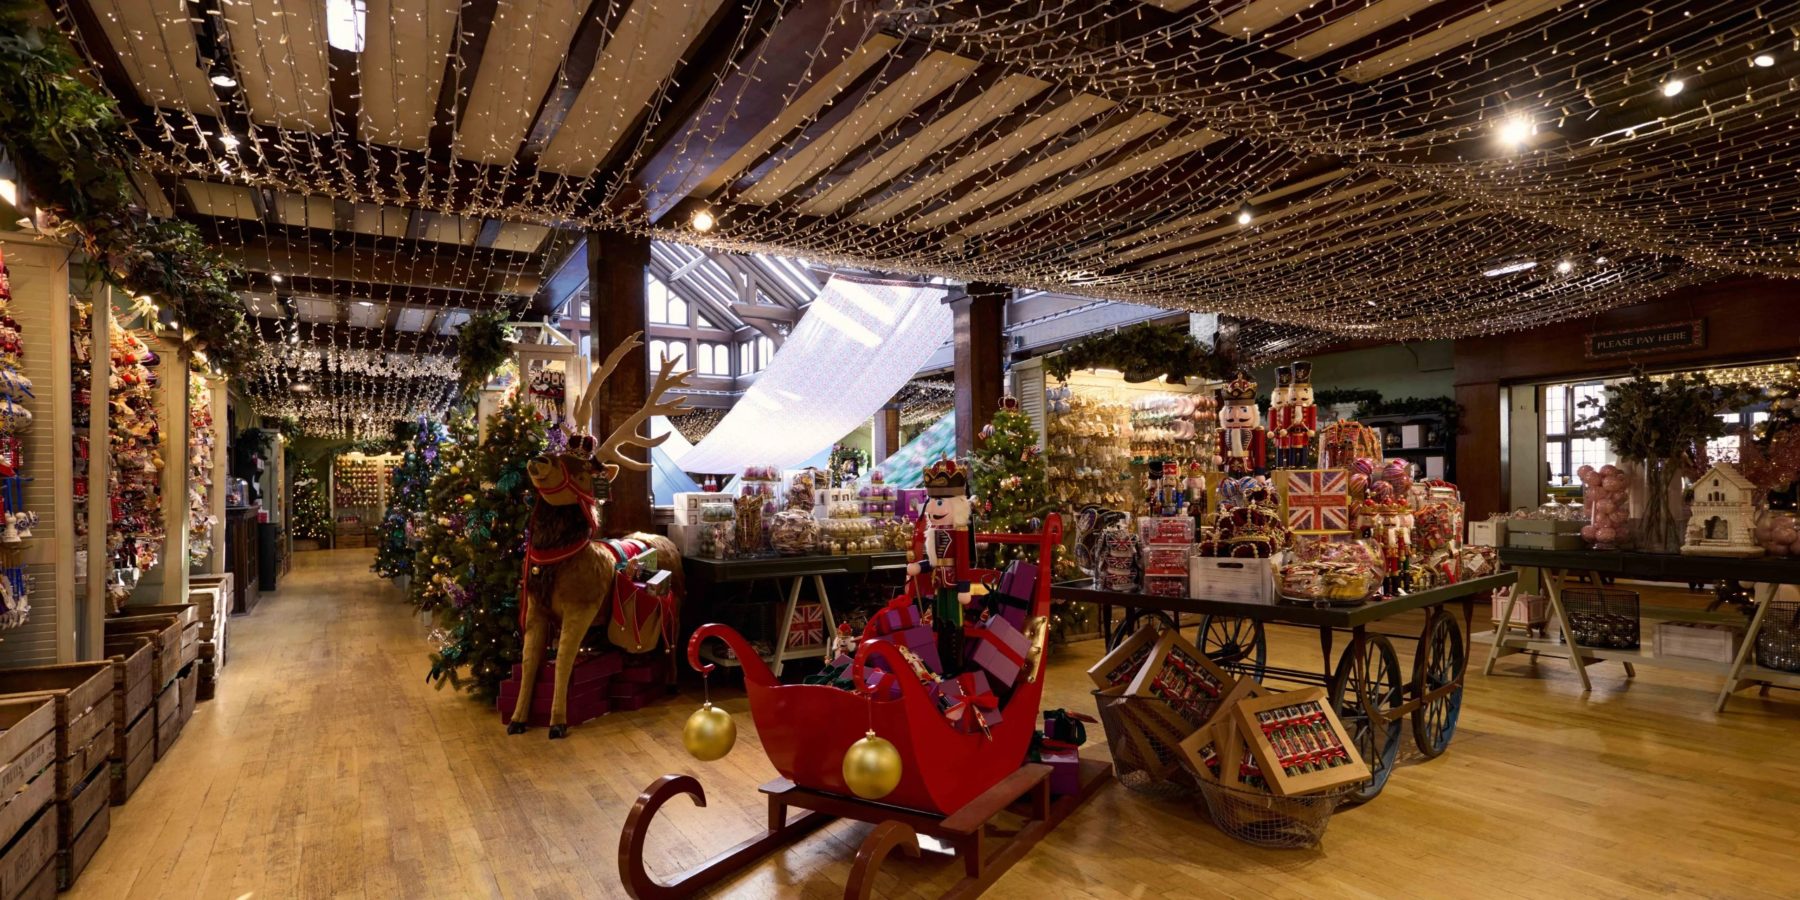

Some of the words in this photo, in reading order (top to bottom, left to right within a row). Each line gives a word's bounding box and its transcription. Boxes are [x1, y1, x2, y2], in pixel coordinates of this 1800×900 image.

[1597, 337, 1633, 349] PLEASE
[1636, 335, 1655, 345] PAY
[1658, 331, 1687, 342] HERE
